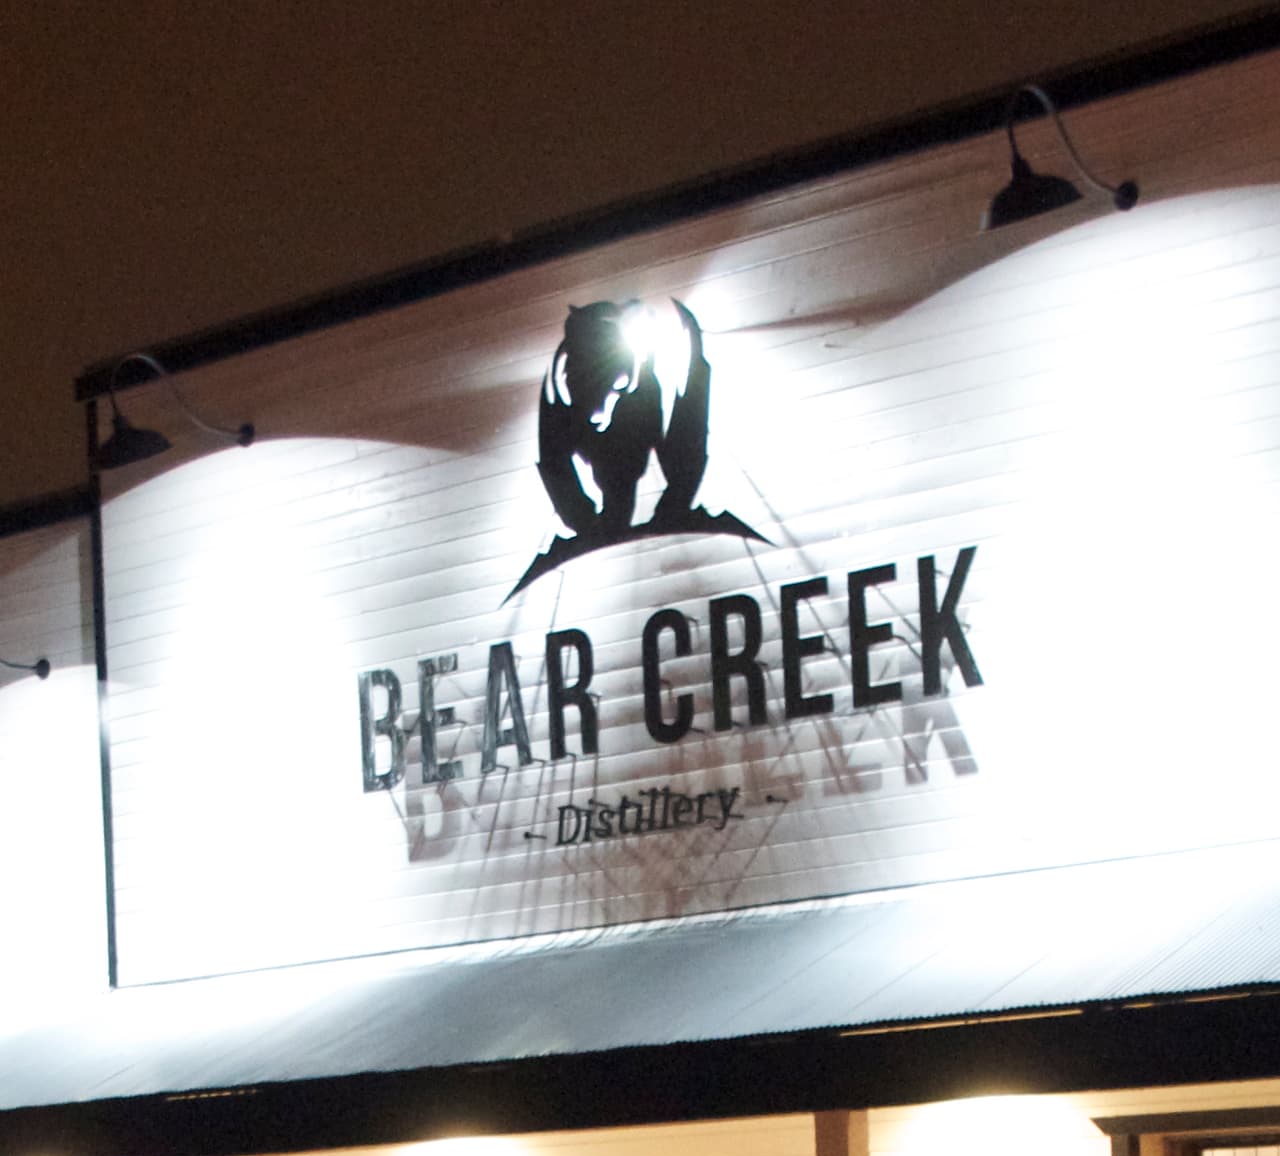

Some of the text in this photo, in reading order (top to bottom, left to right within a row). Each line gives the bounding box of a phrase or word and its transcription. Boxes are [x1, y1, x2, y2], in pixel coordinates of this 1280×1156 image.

[358, 546, 985, 794] BEAR CREEK
[555, 785, 742, 846] Distillery
